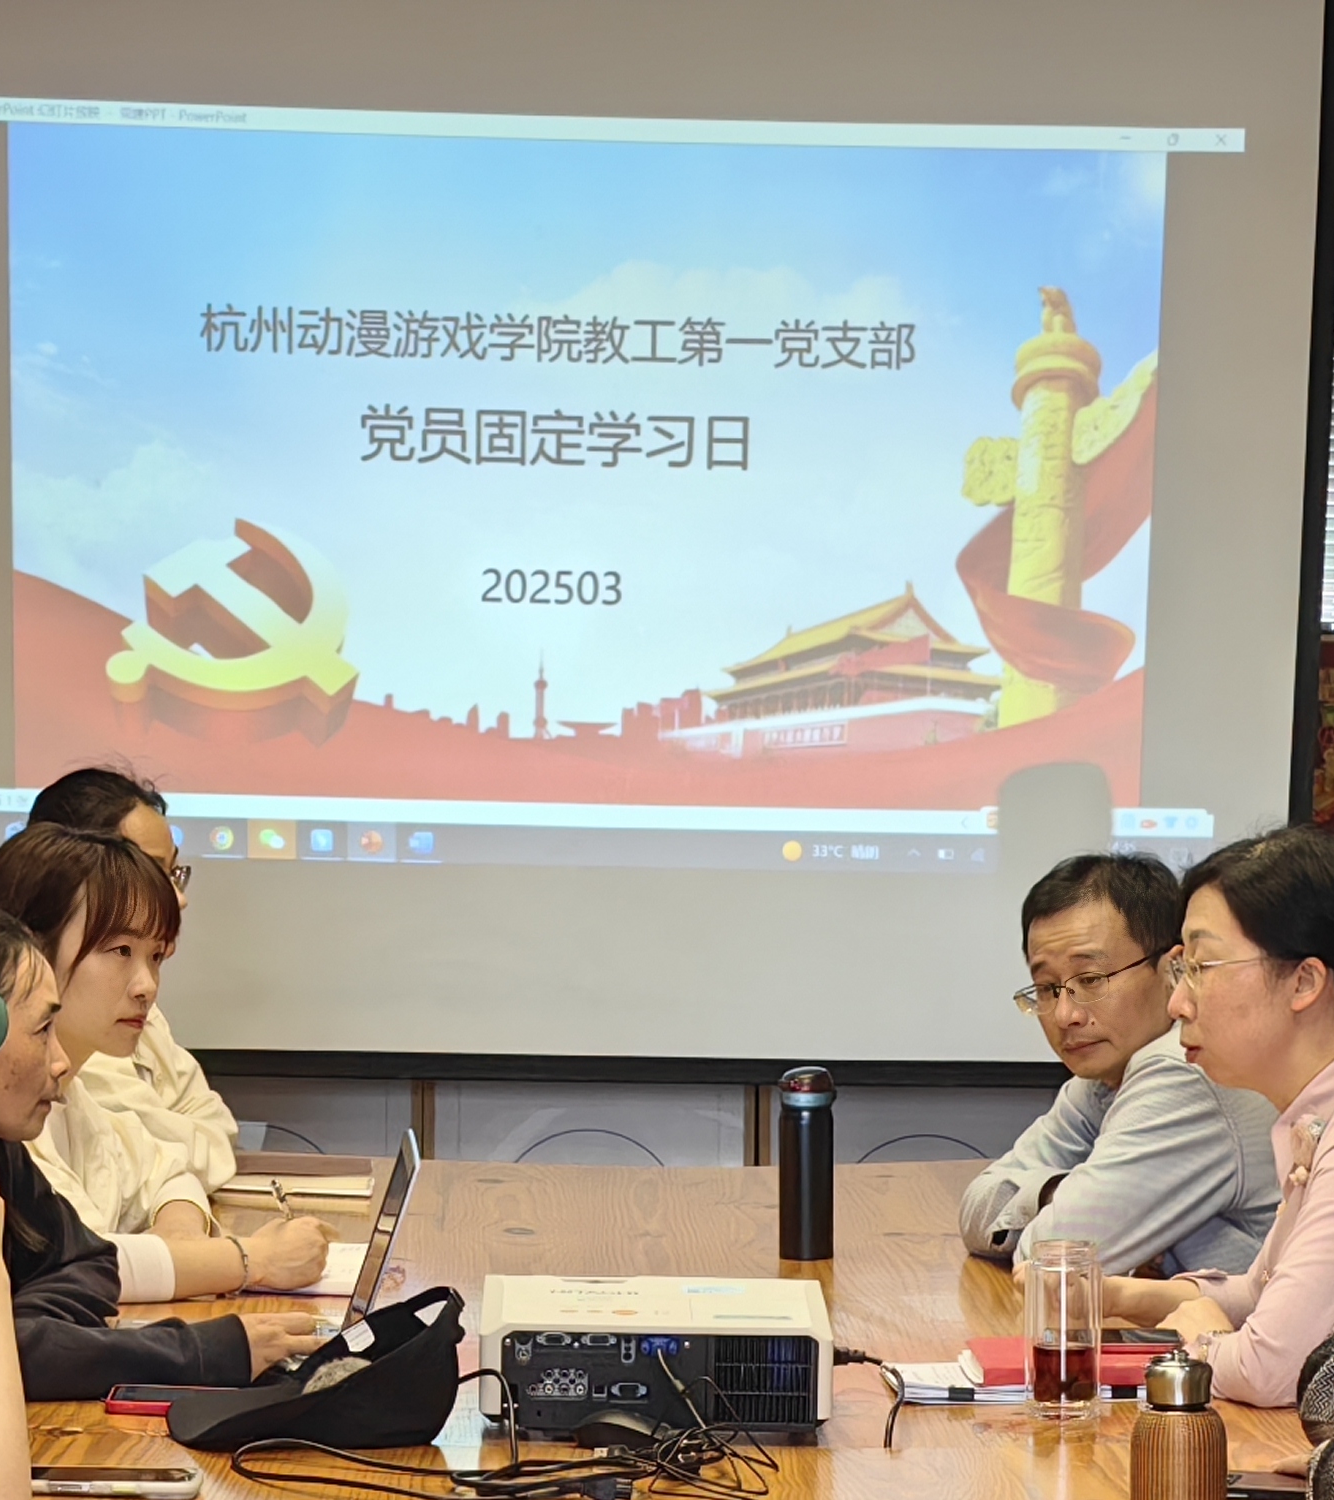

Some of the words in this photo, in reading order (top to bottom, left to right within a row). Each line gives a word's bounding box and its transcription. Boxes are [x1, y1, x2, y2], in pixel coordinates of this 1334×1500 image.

[178, 108, 247, 124] PowerPoint
[200, 301, 917, 372] 杭州动漫游戏学院教工第一党支部
[359, 403, 752, 473] 党员固定学习日
[481, 565, 623, 609] 202503
